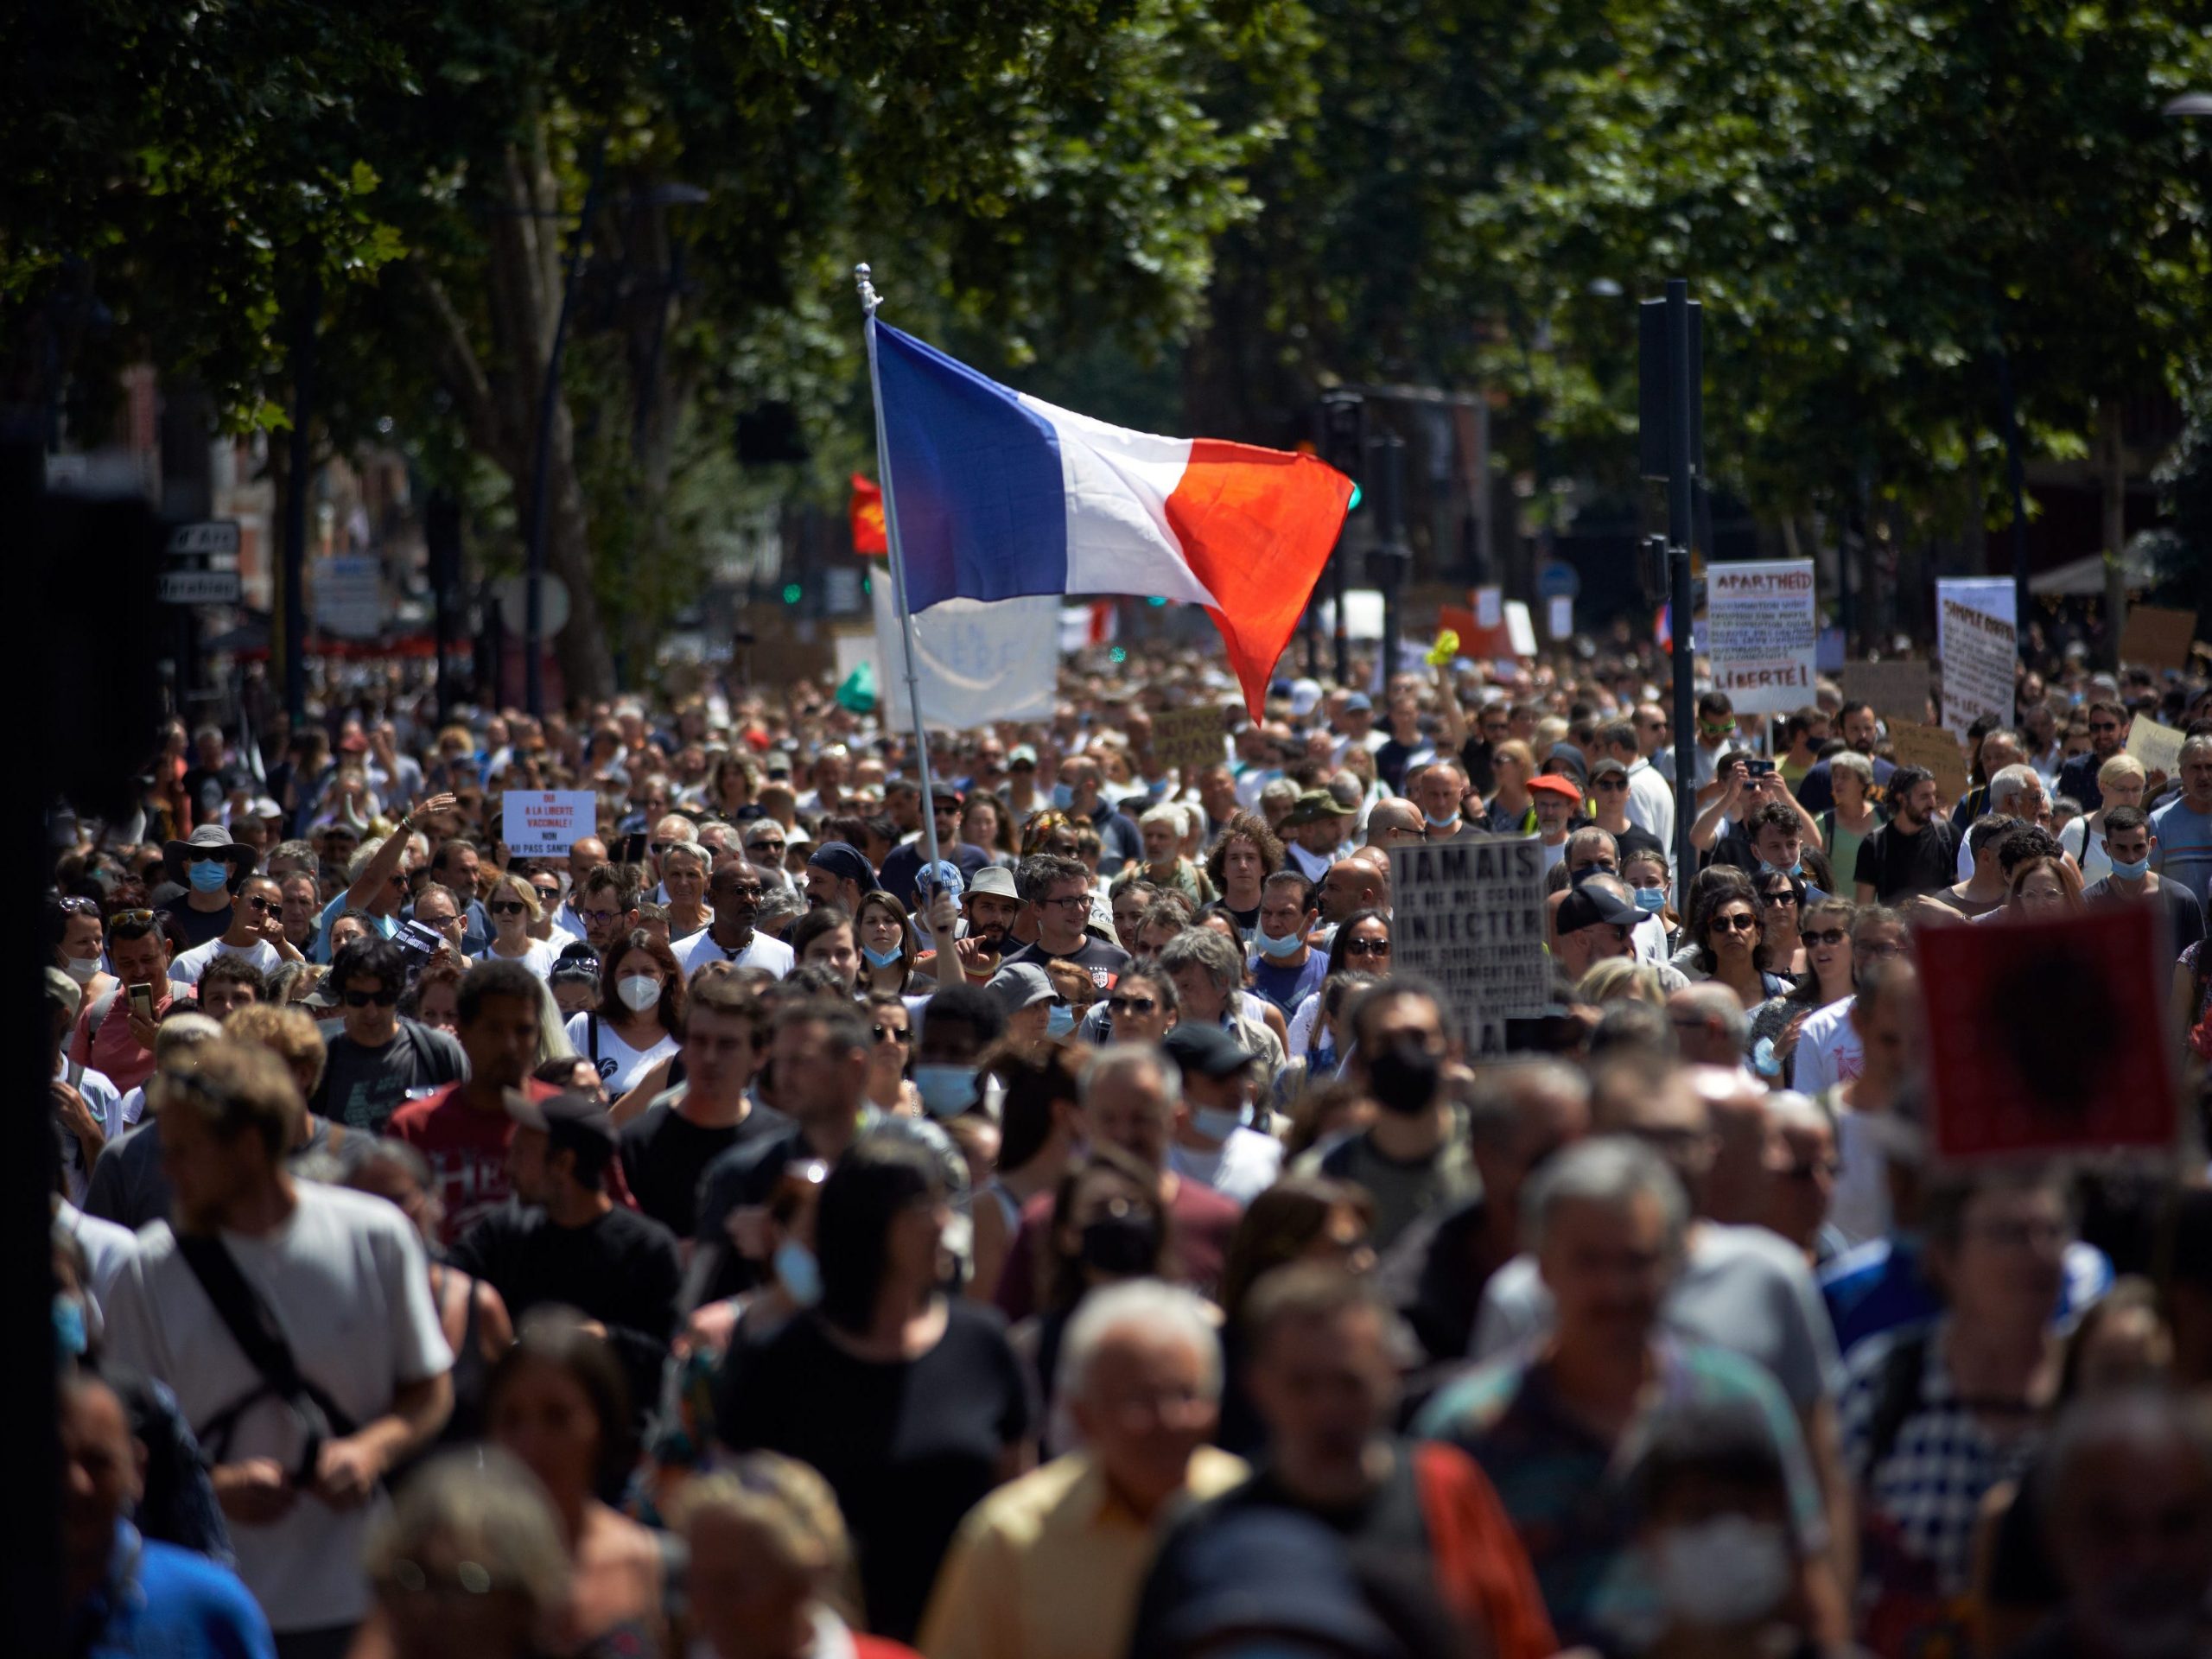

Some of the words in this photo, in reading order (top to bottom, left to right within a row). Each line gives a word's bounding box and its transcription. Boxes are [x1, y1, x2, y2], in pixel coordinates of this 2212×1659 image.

[533, 807, 543, 816] LA
[542, 832, 557, 841] NON
[512, 844, 520, 853] AU
[524, 844, 543, 854] PASS
[1401, 845, 1537, 886] JAMAIS
[1401, 909, 1541, 941] INJECTER
